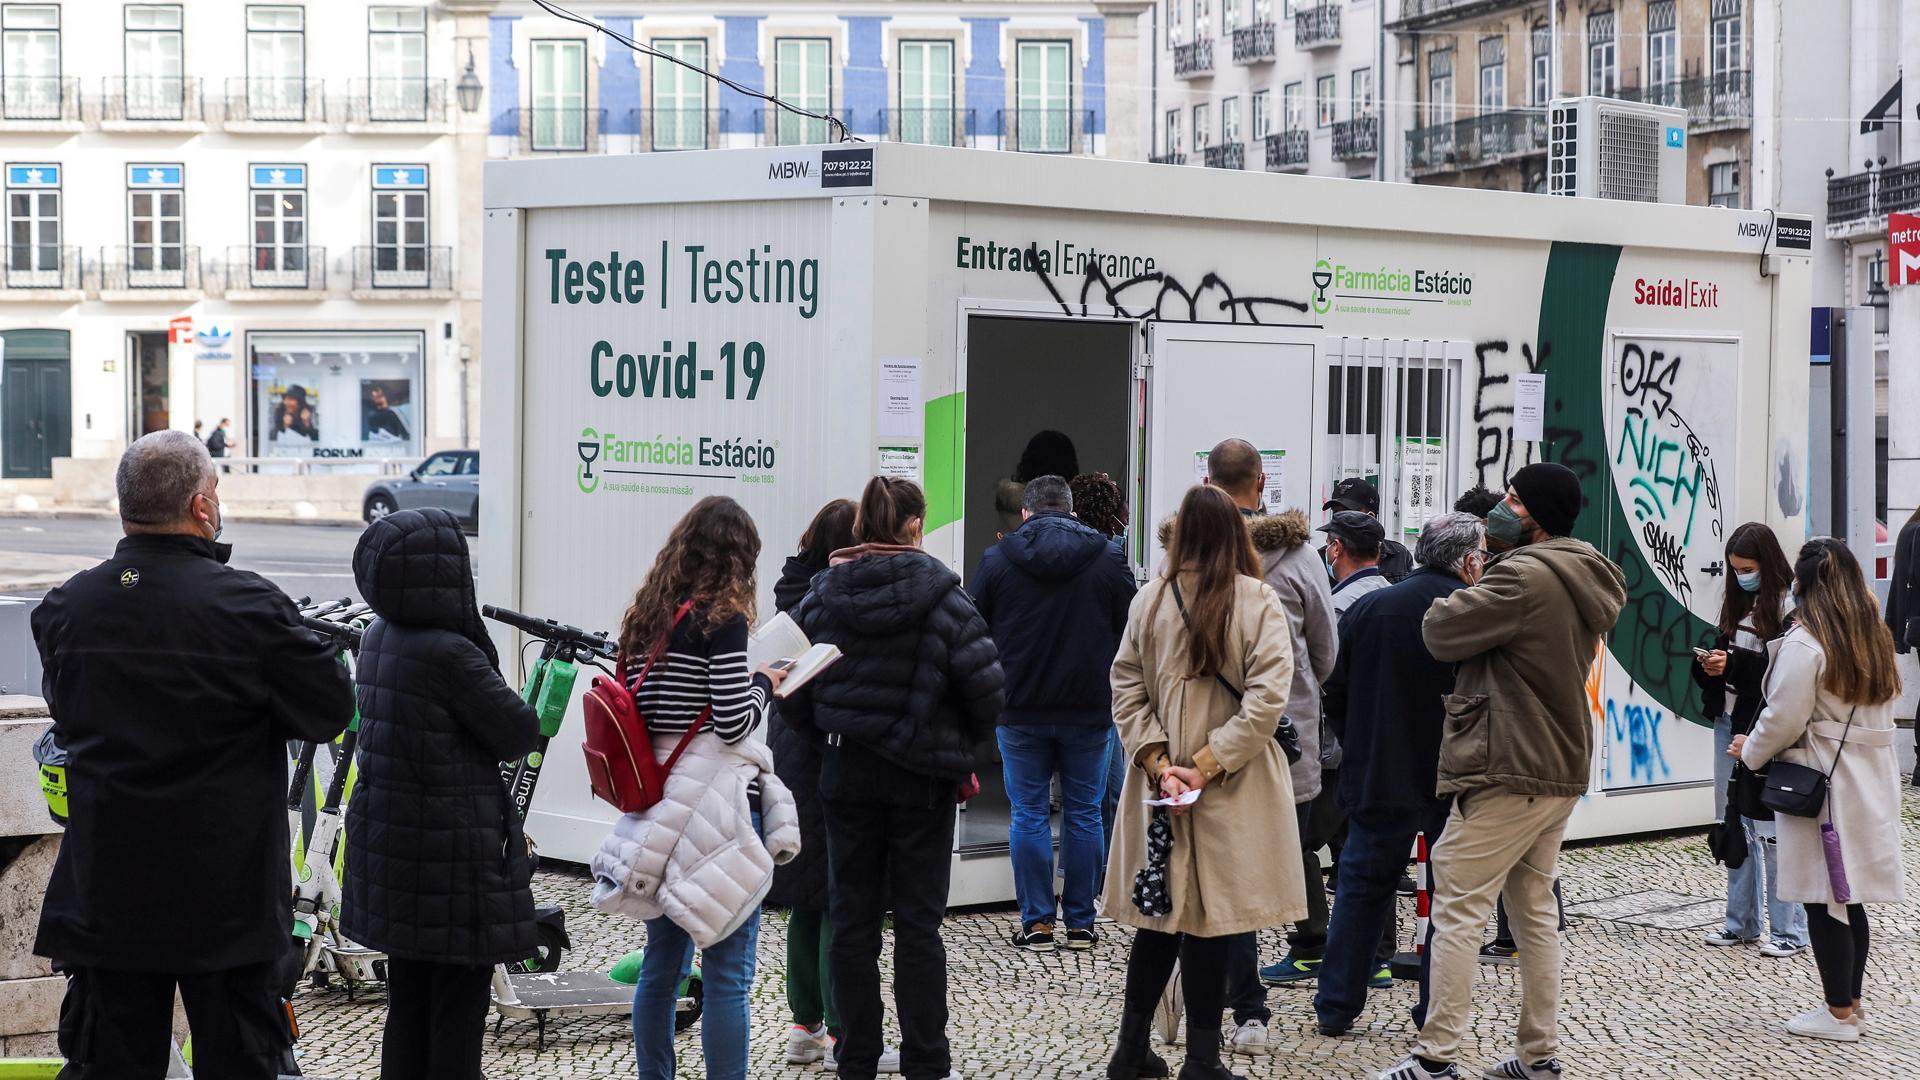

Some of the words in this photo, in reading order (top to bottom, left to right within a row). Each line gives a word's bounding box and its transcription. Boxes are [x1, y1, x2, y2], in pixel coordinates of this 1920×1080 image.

[769, 161, 809, 179] MBW
[1737, 222, 1768, 238] MBW
[546, 248, 645, 304] Teste
[685, 244, 819, 319] Testing
[1335, 264, 1411, 292] Farmácia
[1415, 269, 1472, 295] Estácio
[590, 340, 766, 401] Covid-19
[603, 433, 693, 465] Farmácia
[698, 436, 775, 469] Estácio
[609, 483, 620, 491] sua
[621, 482, 640, 493] saúde
[650, 485, 669, 494] nossa
[742, 474, 761, 483] Desde
[515, 769, 538, 807] Lime
